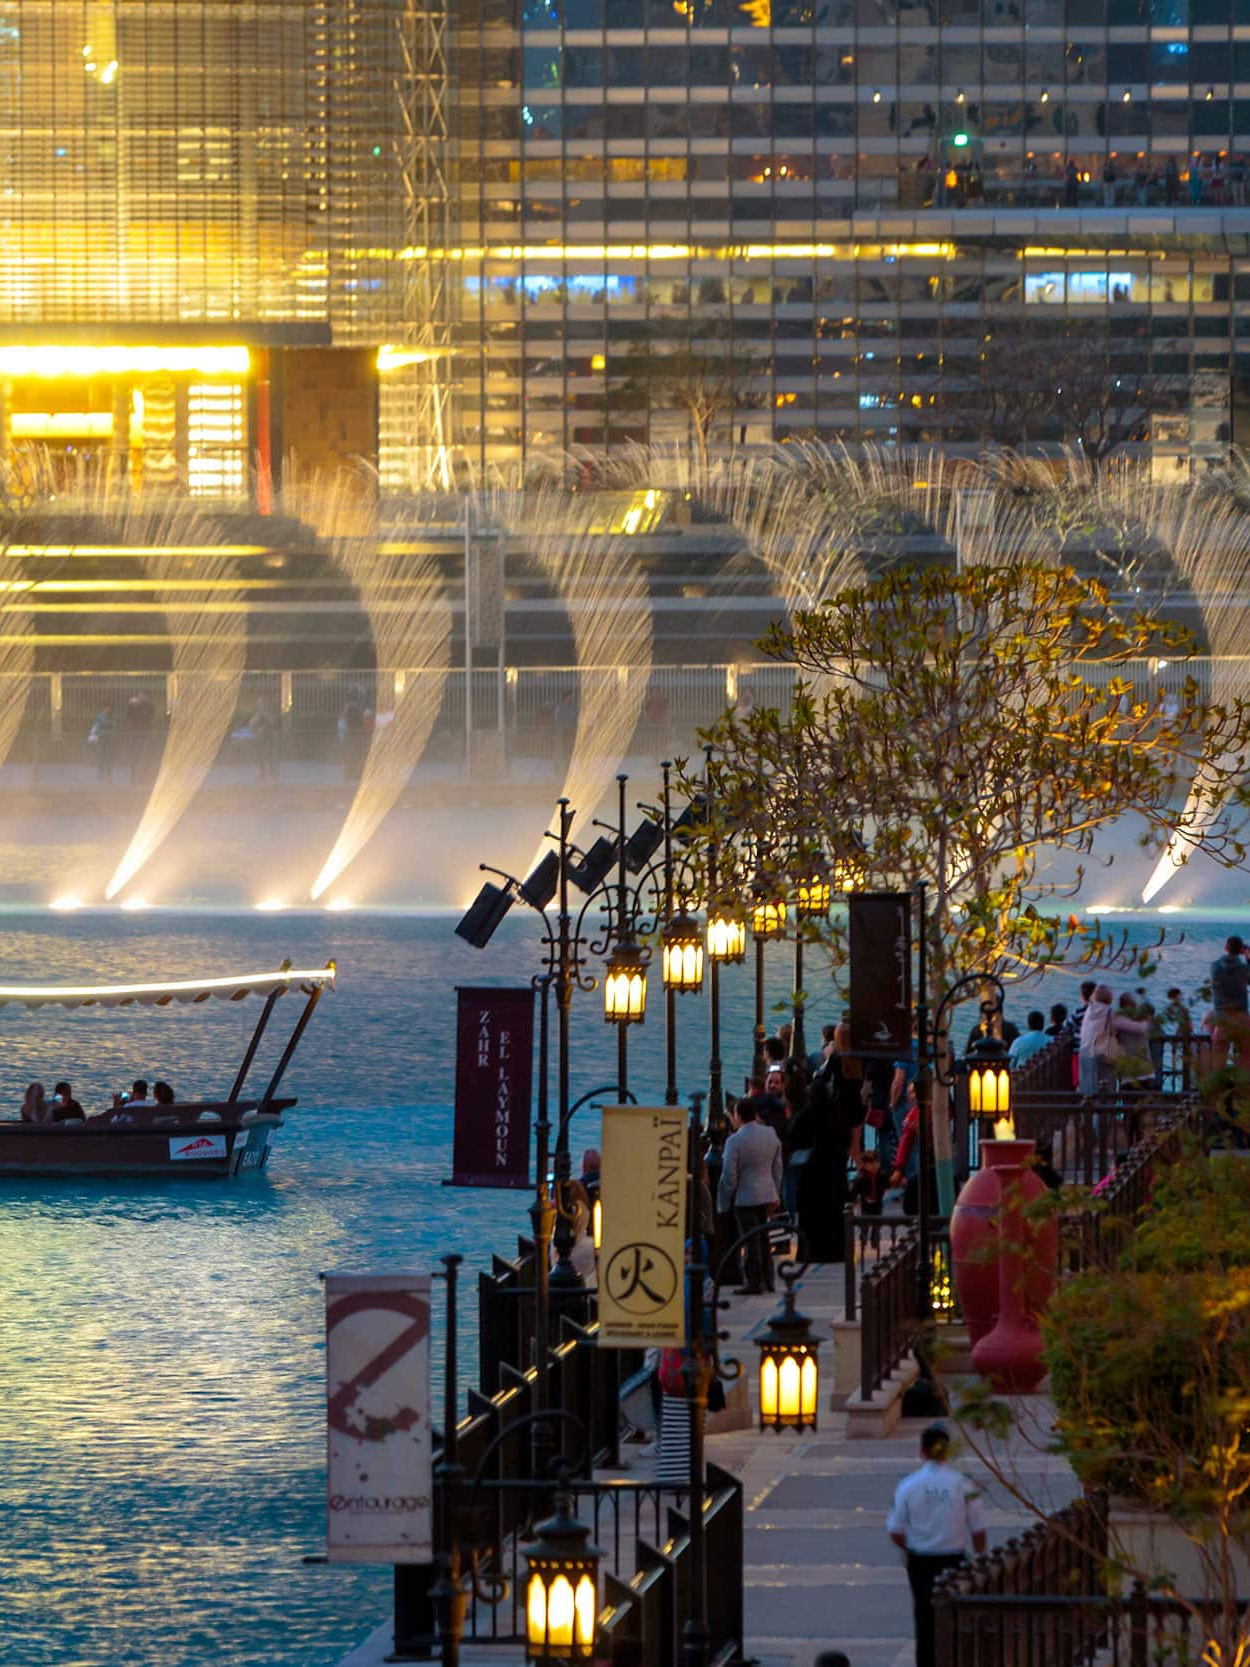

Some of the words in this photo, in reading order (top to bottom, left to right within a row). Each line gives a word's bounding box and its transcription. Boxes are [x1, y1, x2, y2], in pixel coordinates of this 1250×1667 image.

[477, 1010, 491, 1067] ZAHR
[499, 1031, 510, 1059] EL
[495, 1067, 510, 1166] LAYMOUN
